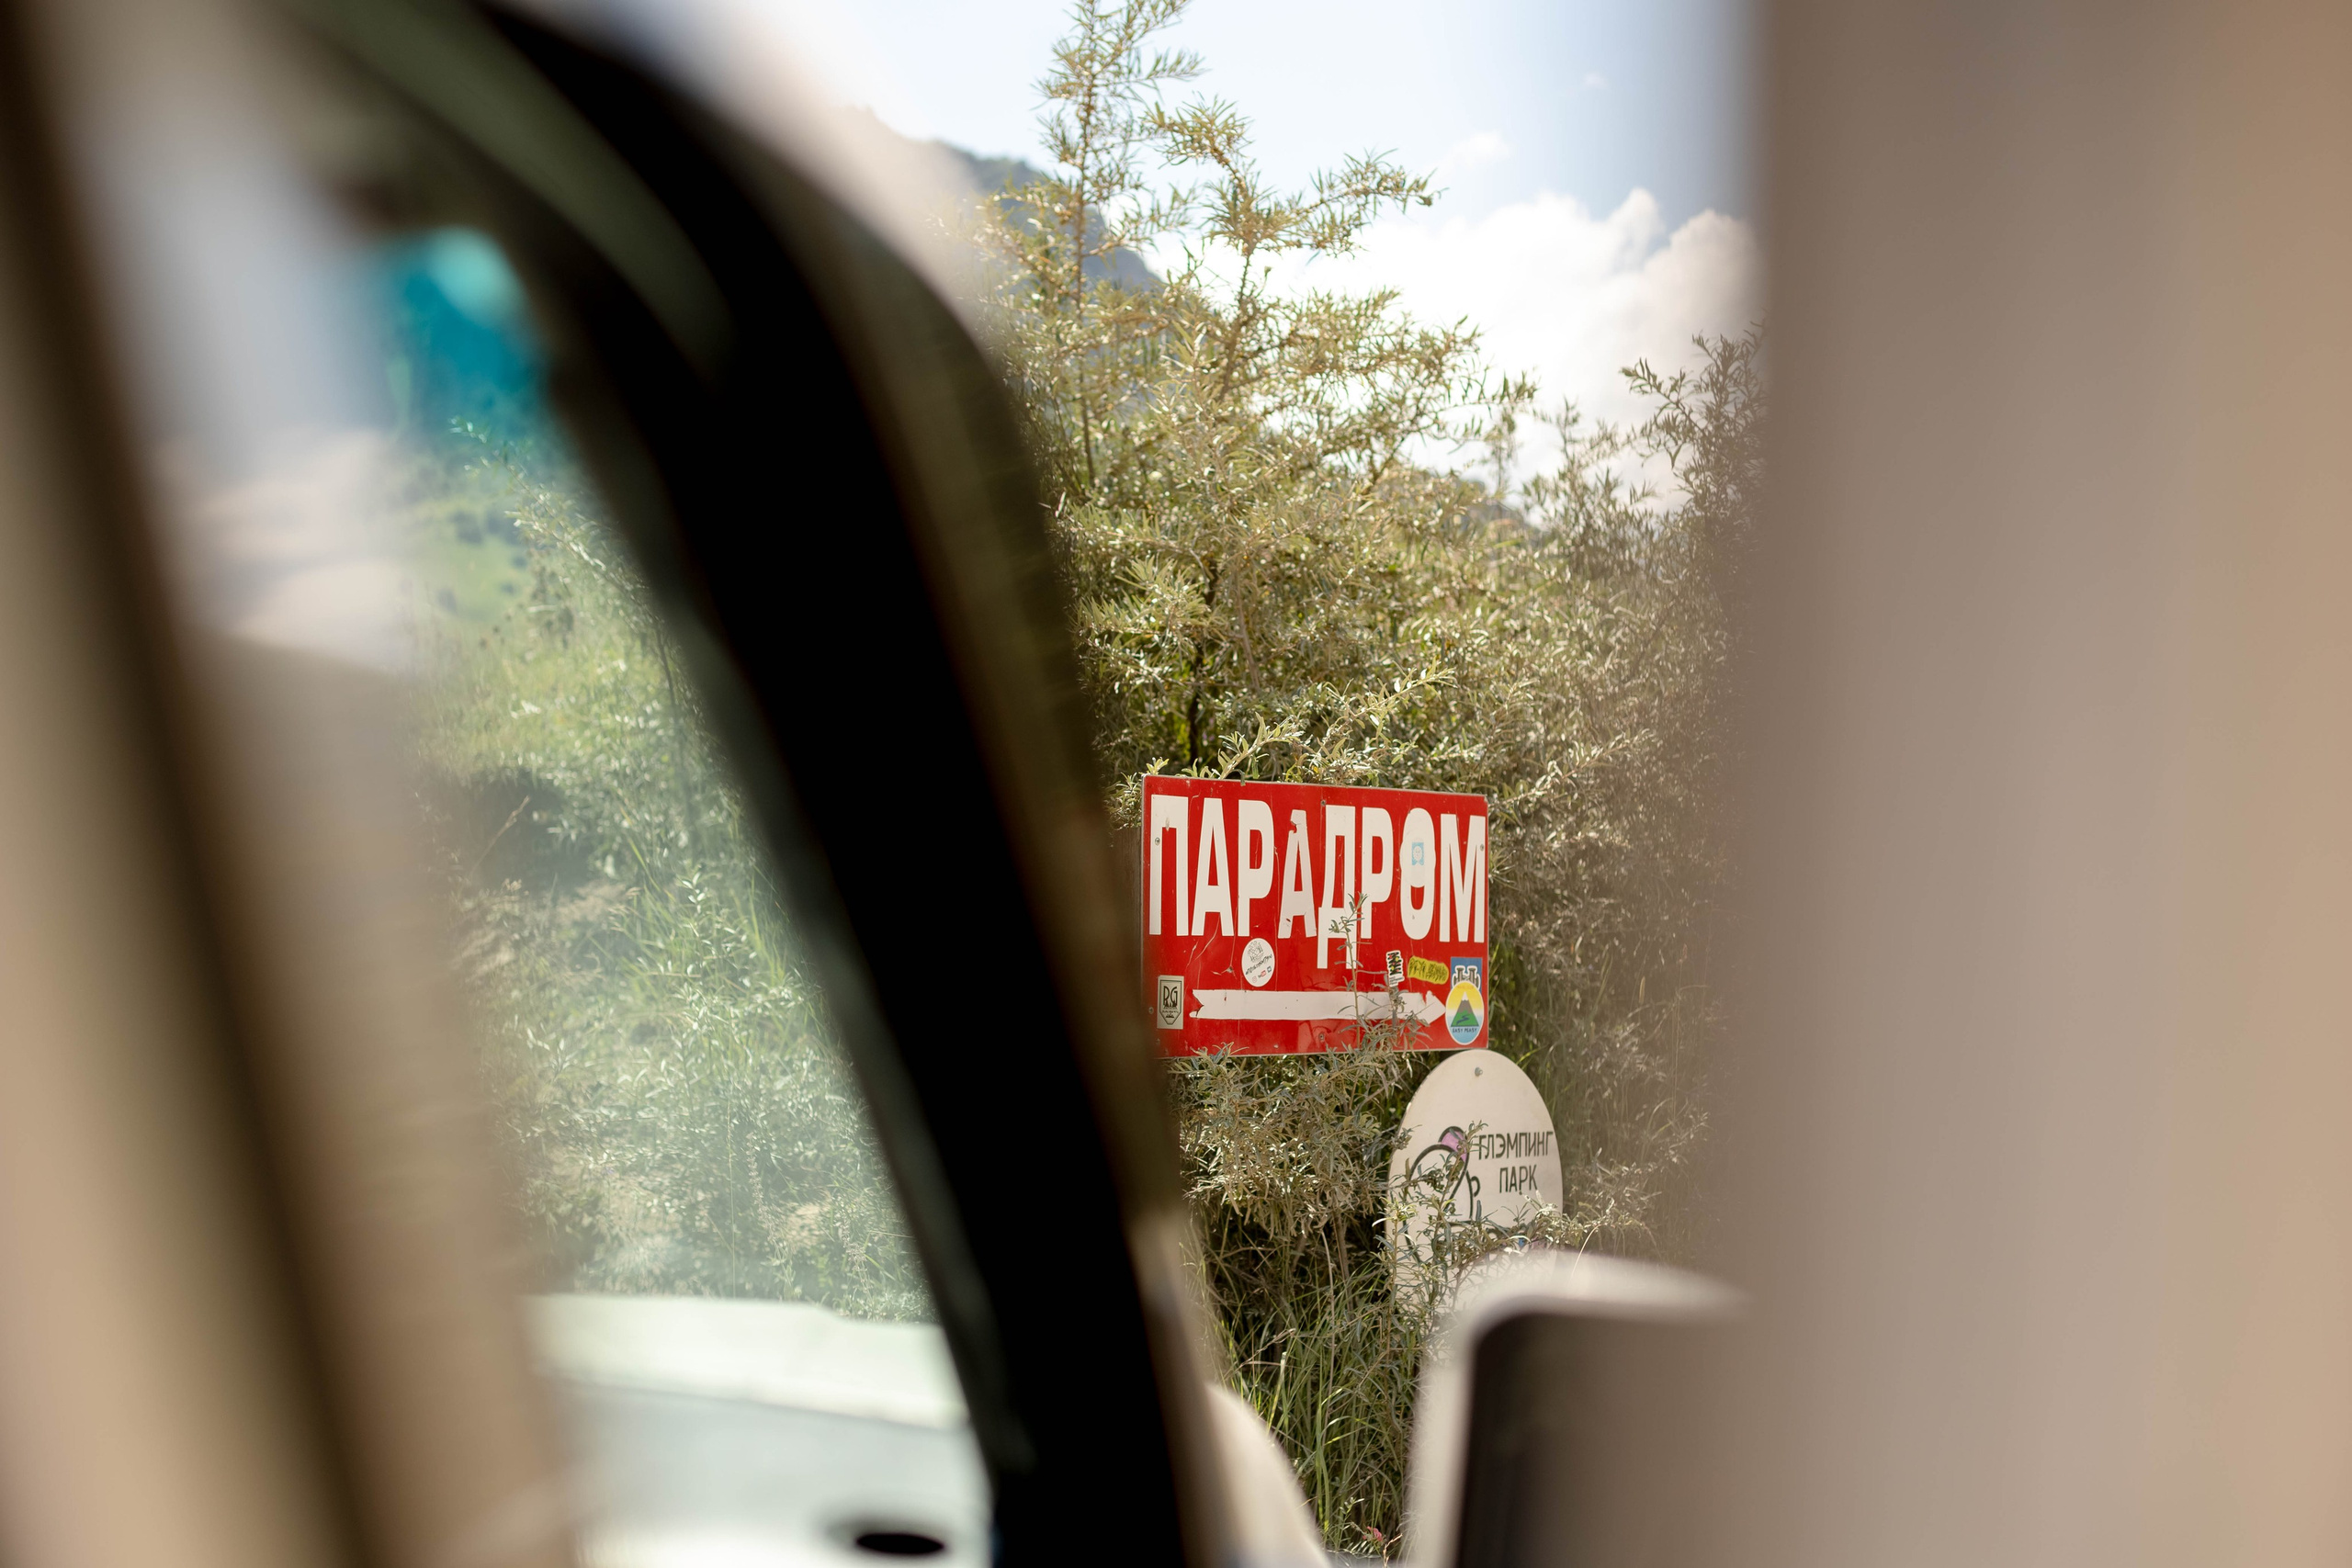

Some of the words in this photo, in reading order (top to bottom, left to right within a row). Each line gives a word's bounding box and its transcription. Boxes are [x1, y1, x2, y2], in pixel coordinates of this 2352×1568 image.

[1148, 795, 1486, 969] ПАРАДРОМ
[1478, 1131, 1554, 1160] ГЛЭМПИНГ
[1499, 1164, 1538, 1194] ПАРК
